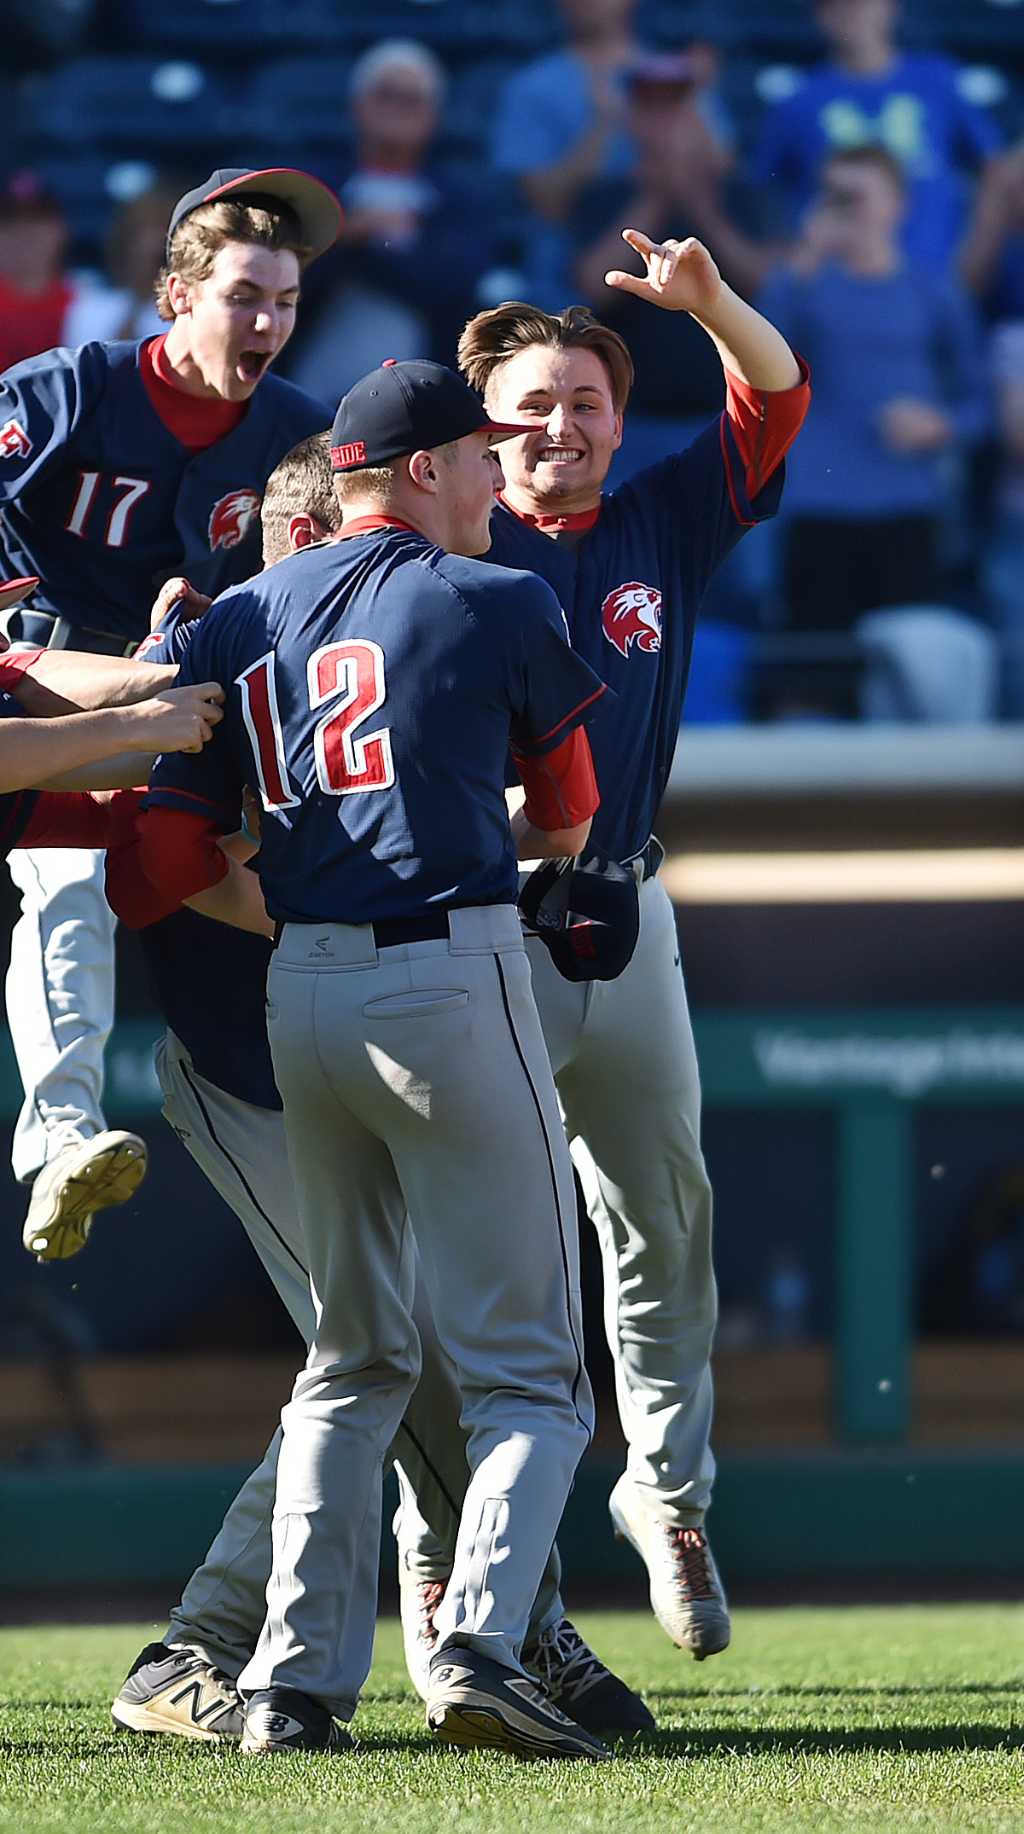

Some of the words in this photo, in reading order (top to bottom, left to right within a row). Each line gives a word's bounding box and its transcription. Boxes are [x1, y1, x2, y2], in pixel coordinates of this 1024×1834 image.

[65, 471, 153, 548] 17
[234, 638, 395, 812] 12
[169, 1680, 226, 1723] N
